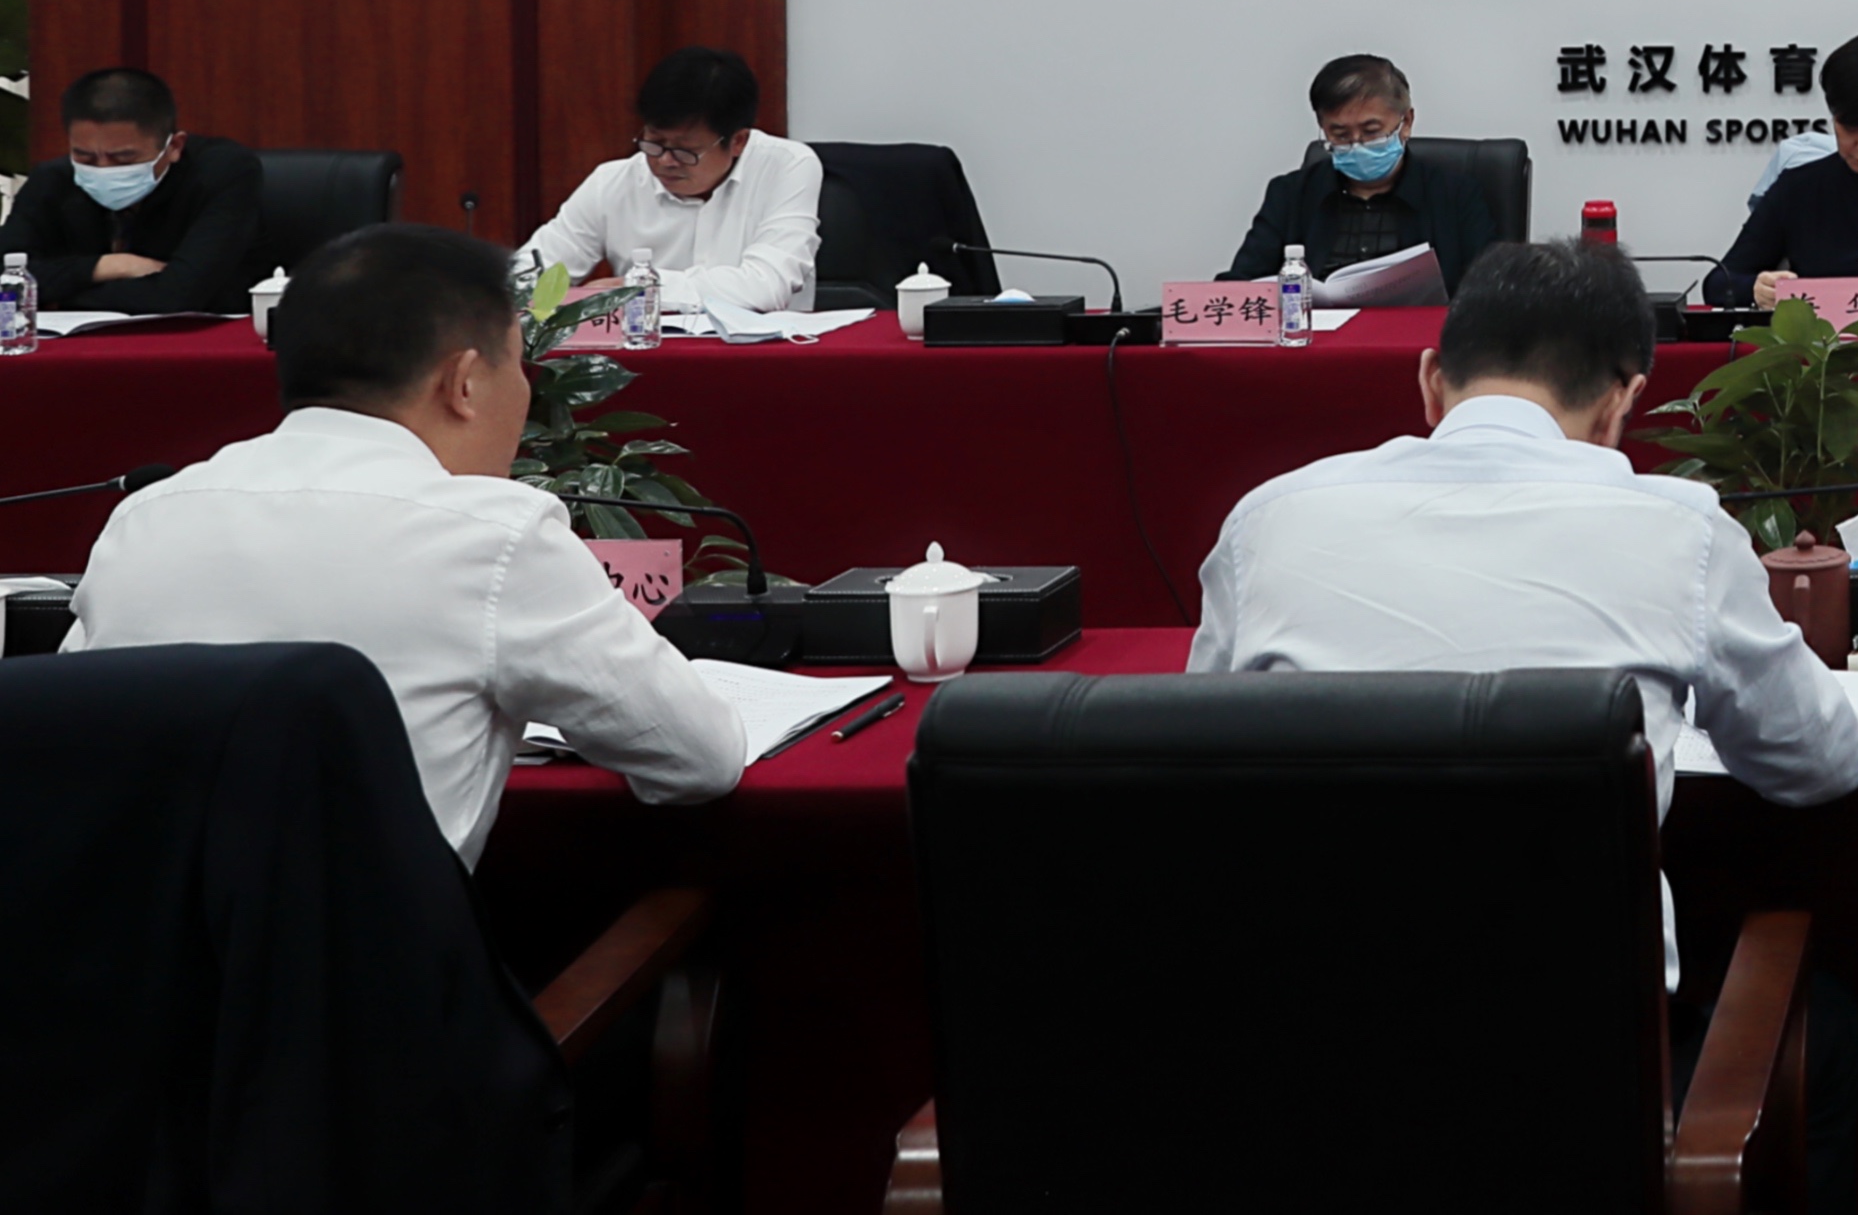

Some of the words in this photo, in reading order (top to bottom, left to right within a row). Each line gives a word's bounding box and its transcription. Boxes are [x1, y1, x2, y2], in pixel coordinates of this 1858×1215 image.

[1557, 119, 1687, 145] WUHAN
[1163, 295, 1277, 327] 毛学锋
